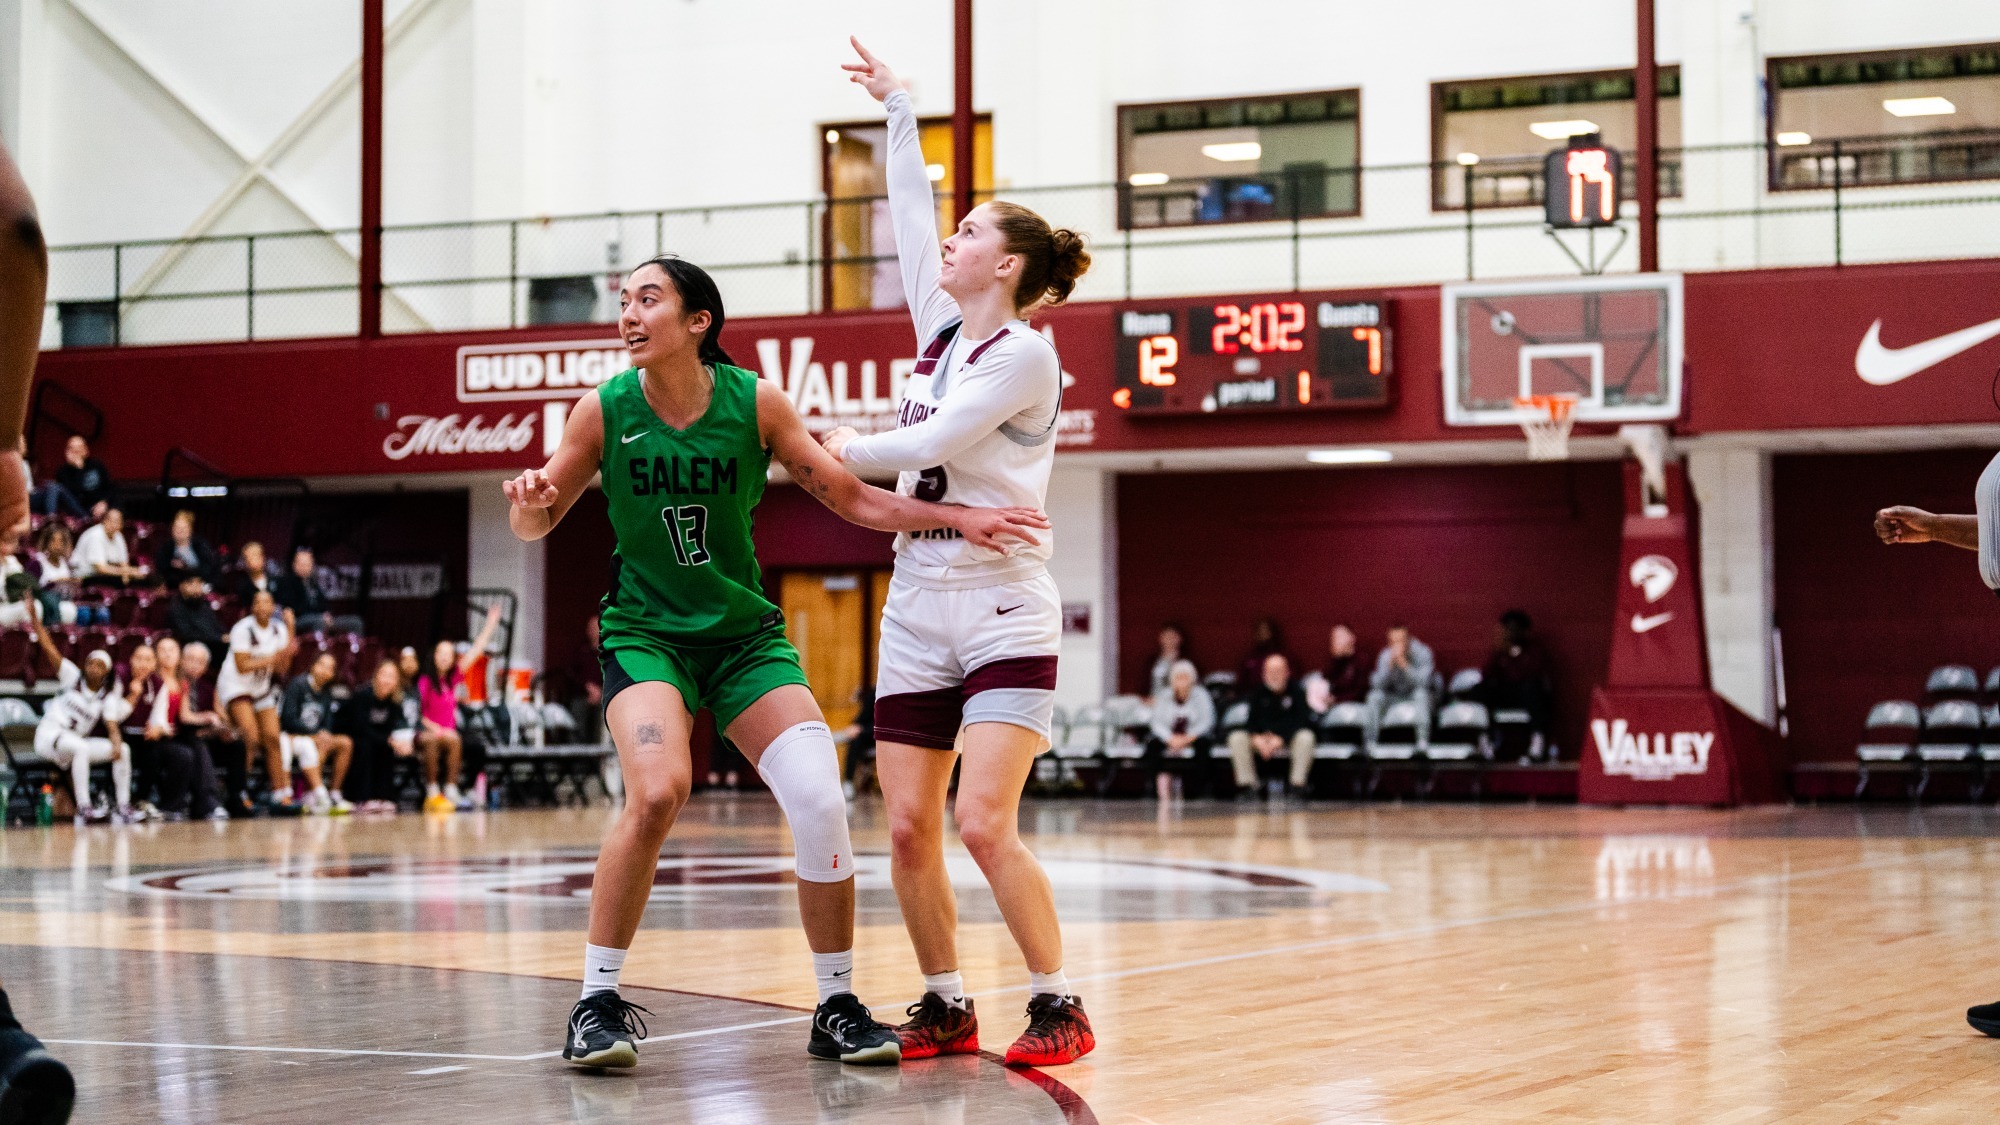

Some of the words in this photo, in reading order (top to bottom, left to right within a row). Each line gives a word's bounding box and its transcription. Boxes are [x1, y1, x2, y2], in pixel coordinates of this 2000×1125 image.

[1212, 302, 1306, 353] 2:02
[1353, 328, 1382, 375] 7
[465, 352, 545, 391] BUD
[545, 348, 632, 388] LIGH
[756, 337, 918, 416] VALLE
[1139, 336, 1178, 386] 12
[1298, 370, 1310, 404] 1
[383, 412, 538, 460] Michelob
[629, 456, 738, 496] SALEM
[662, 505, 711, 566] 13
[1591, 719, 1715, 767] VALLEY
